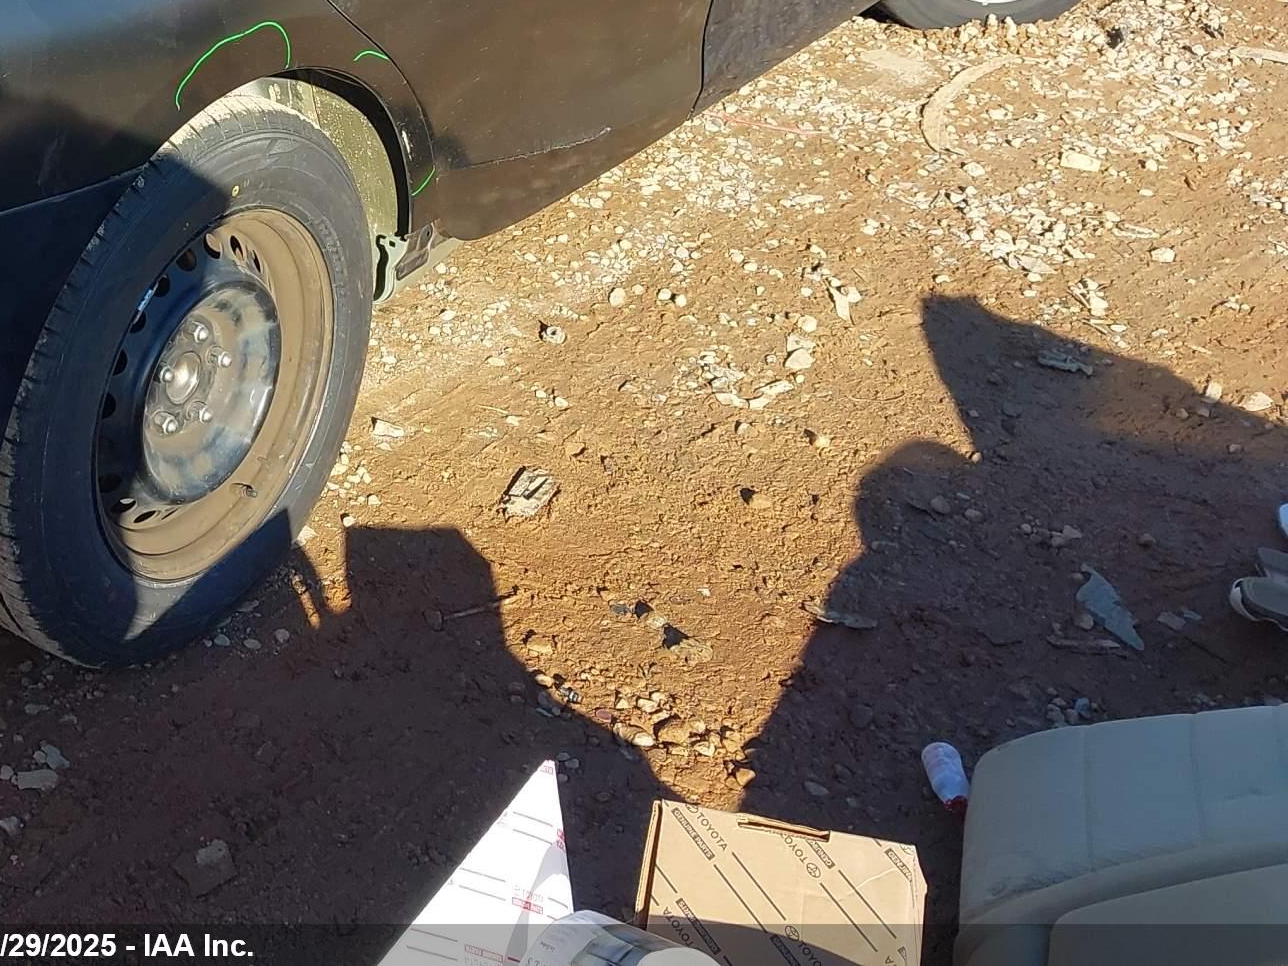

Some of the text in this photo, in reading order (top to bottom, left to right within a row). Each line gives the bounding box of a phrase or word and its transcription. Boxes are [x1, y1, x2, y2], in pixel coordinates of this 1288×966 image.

[673, 810, 714, 859] GENUINE PARTS
[696, 813, 728, 852] TOYOTA
[662, 906, 694, 947] TOYOTA
